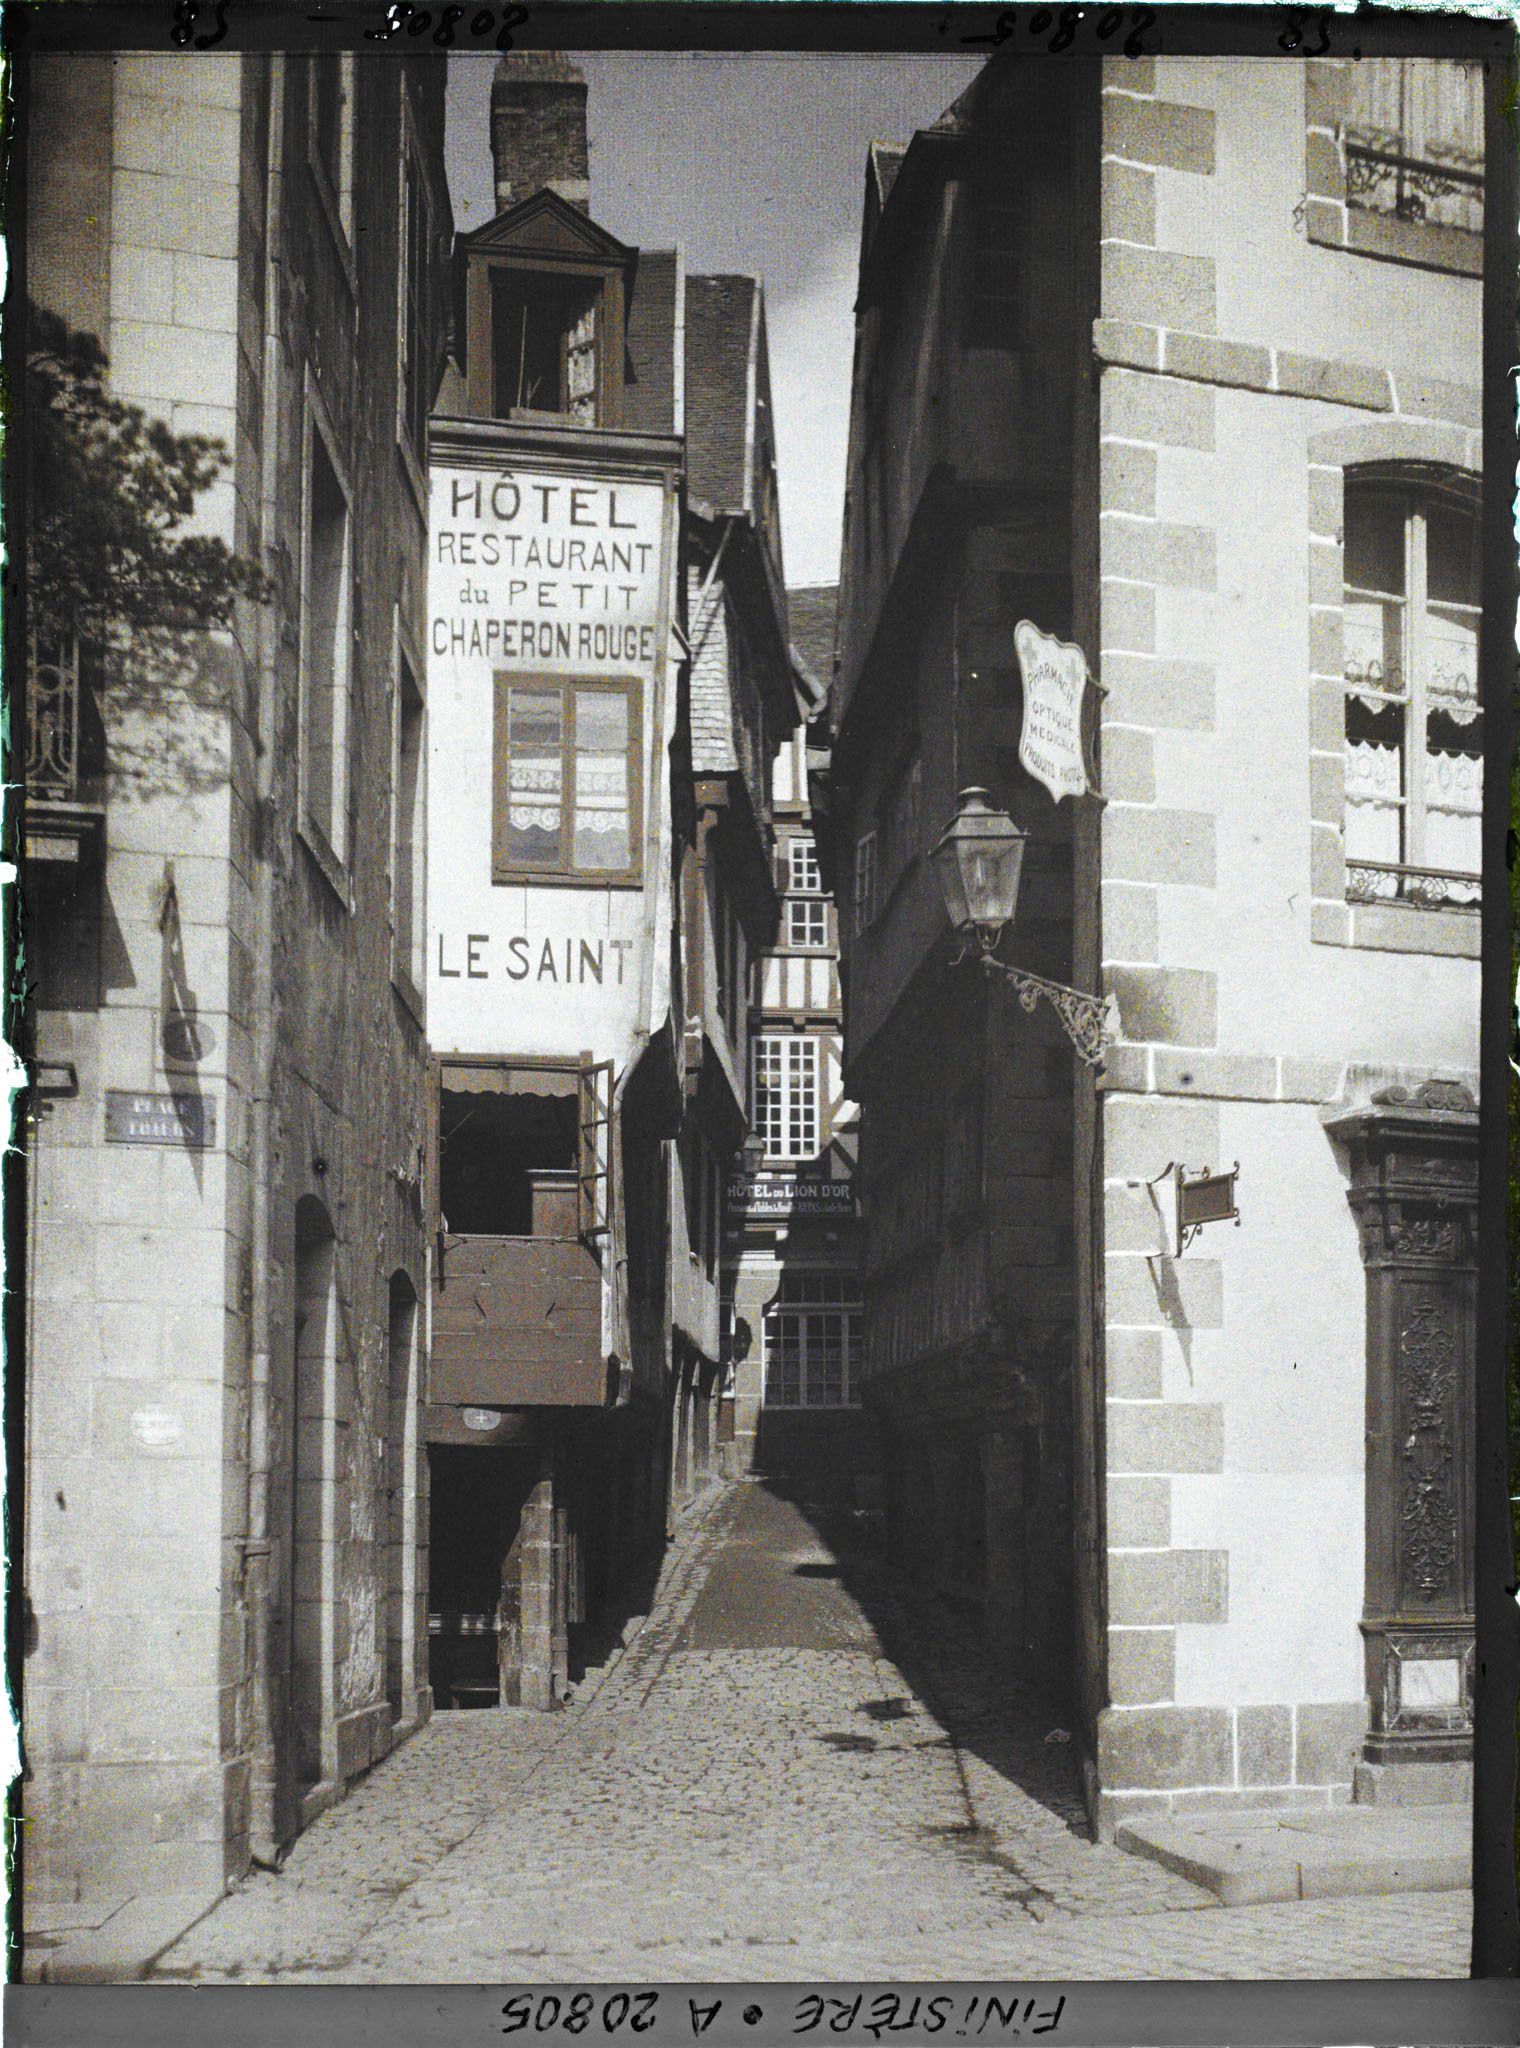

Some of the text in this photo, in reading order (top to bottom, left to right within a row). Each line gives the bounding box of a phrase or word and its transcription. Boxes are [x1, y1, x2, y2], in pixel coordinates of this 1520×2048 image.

[451, 471, 638, 529] HÔTEL
[438, 531, 653, 574] RESTAURANT
[459, 578, 639, 611] du PETIT
[432, 617, 655, 662] CHAPERON ROUGE
[1032, 700, 1074, 732] OPTIQUE
[438, 933, 634, 985] LE SAINT
[785, 1184, 817, 1198] LION
[822, 1184, 850, 1199] D'OR
[502, 1991, 660, 2035] 20805
[689, 1999, 723, 2038] A
